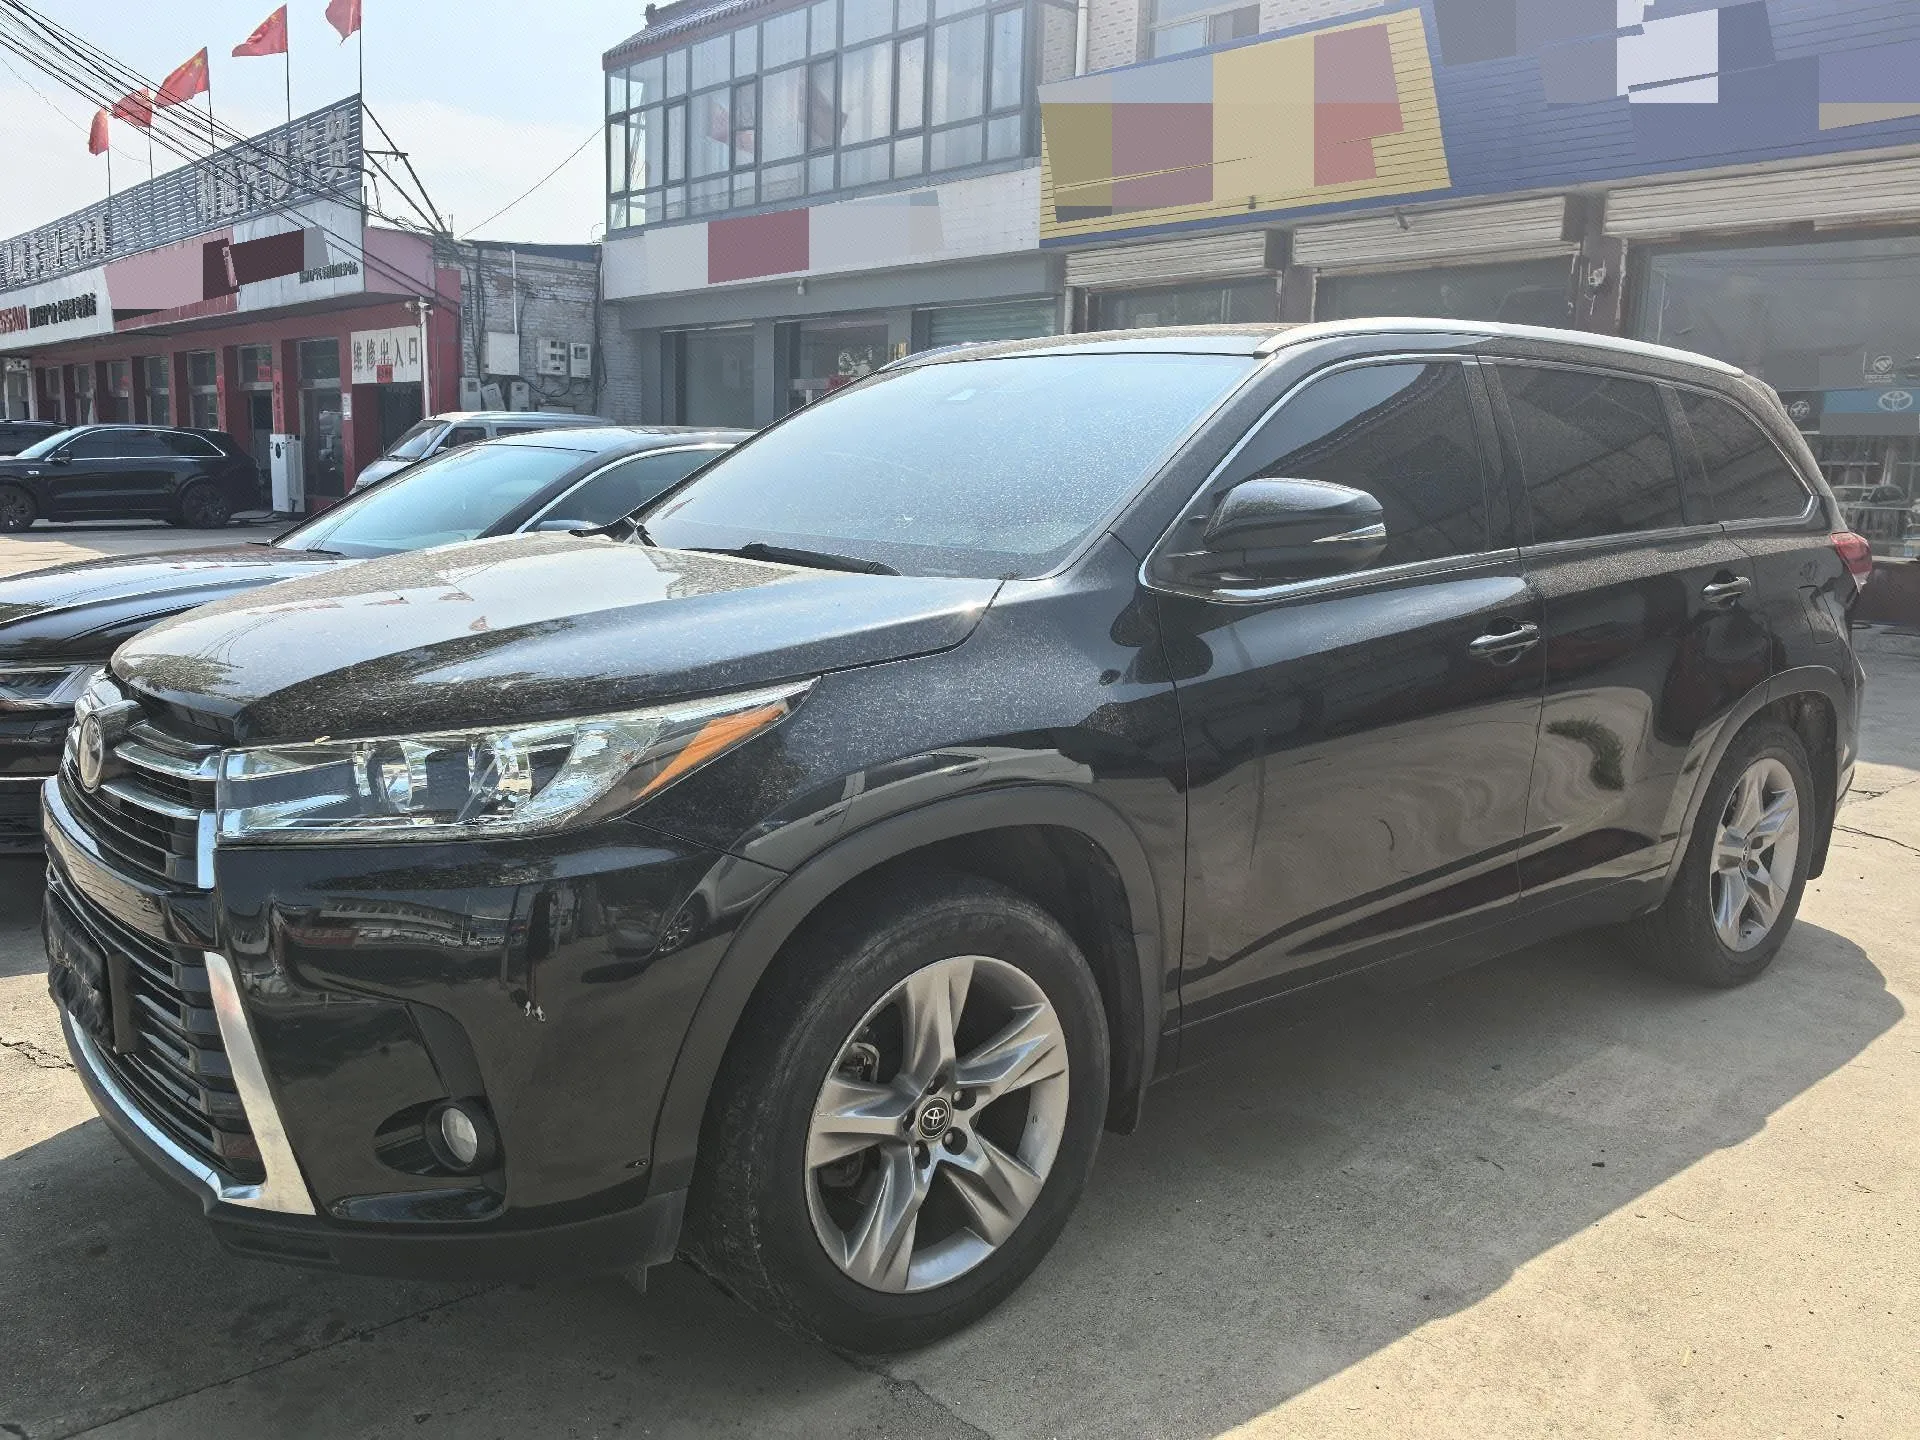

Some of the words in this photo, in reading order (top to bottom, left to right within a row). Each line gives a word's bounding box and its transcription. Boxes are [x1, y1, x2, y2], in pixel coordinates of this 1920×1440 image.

[353, 337, 418, 372] 维修出入口
